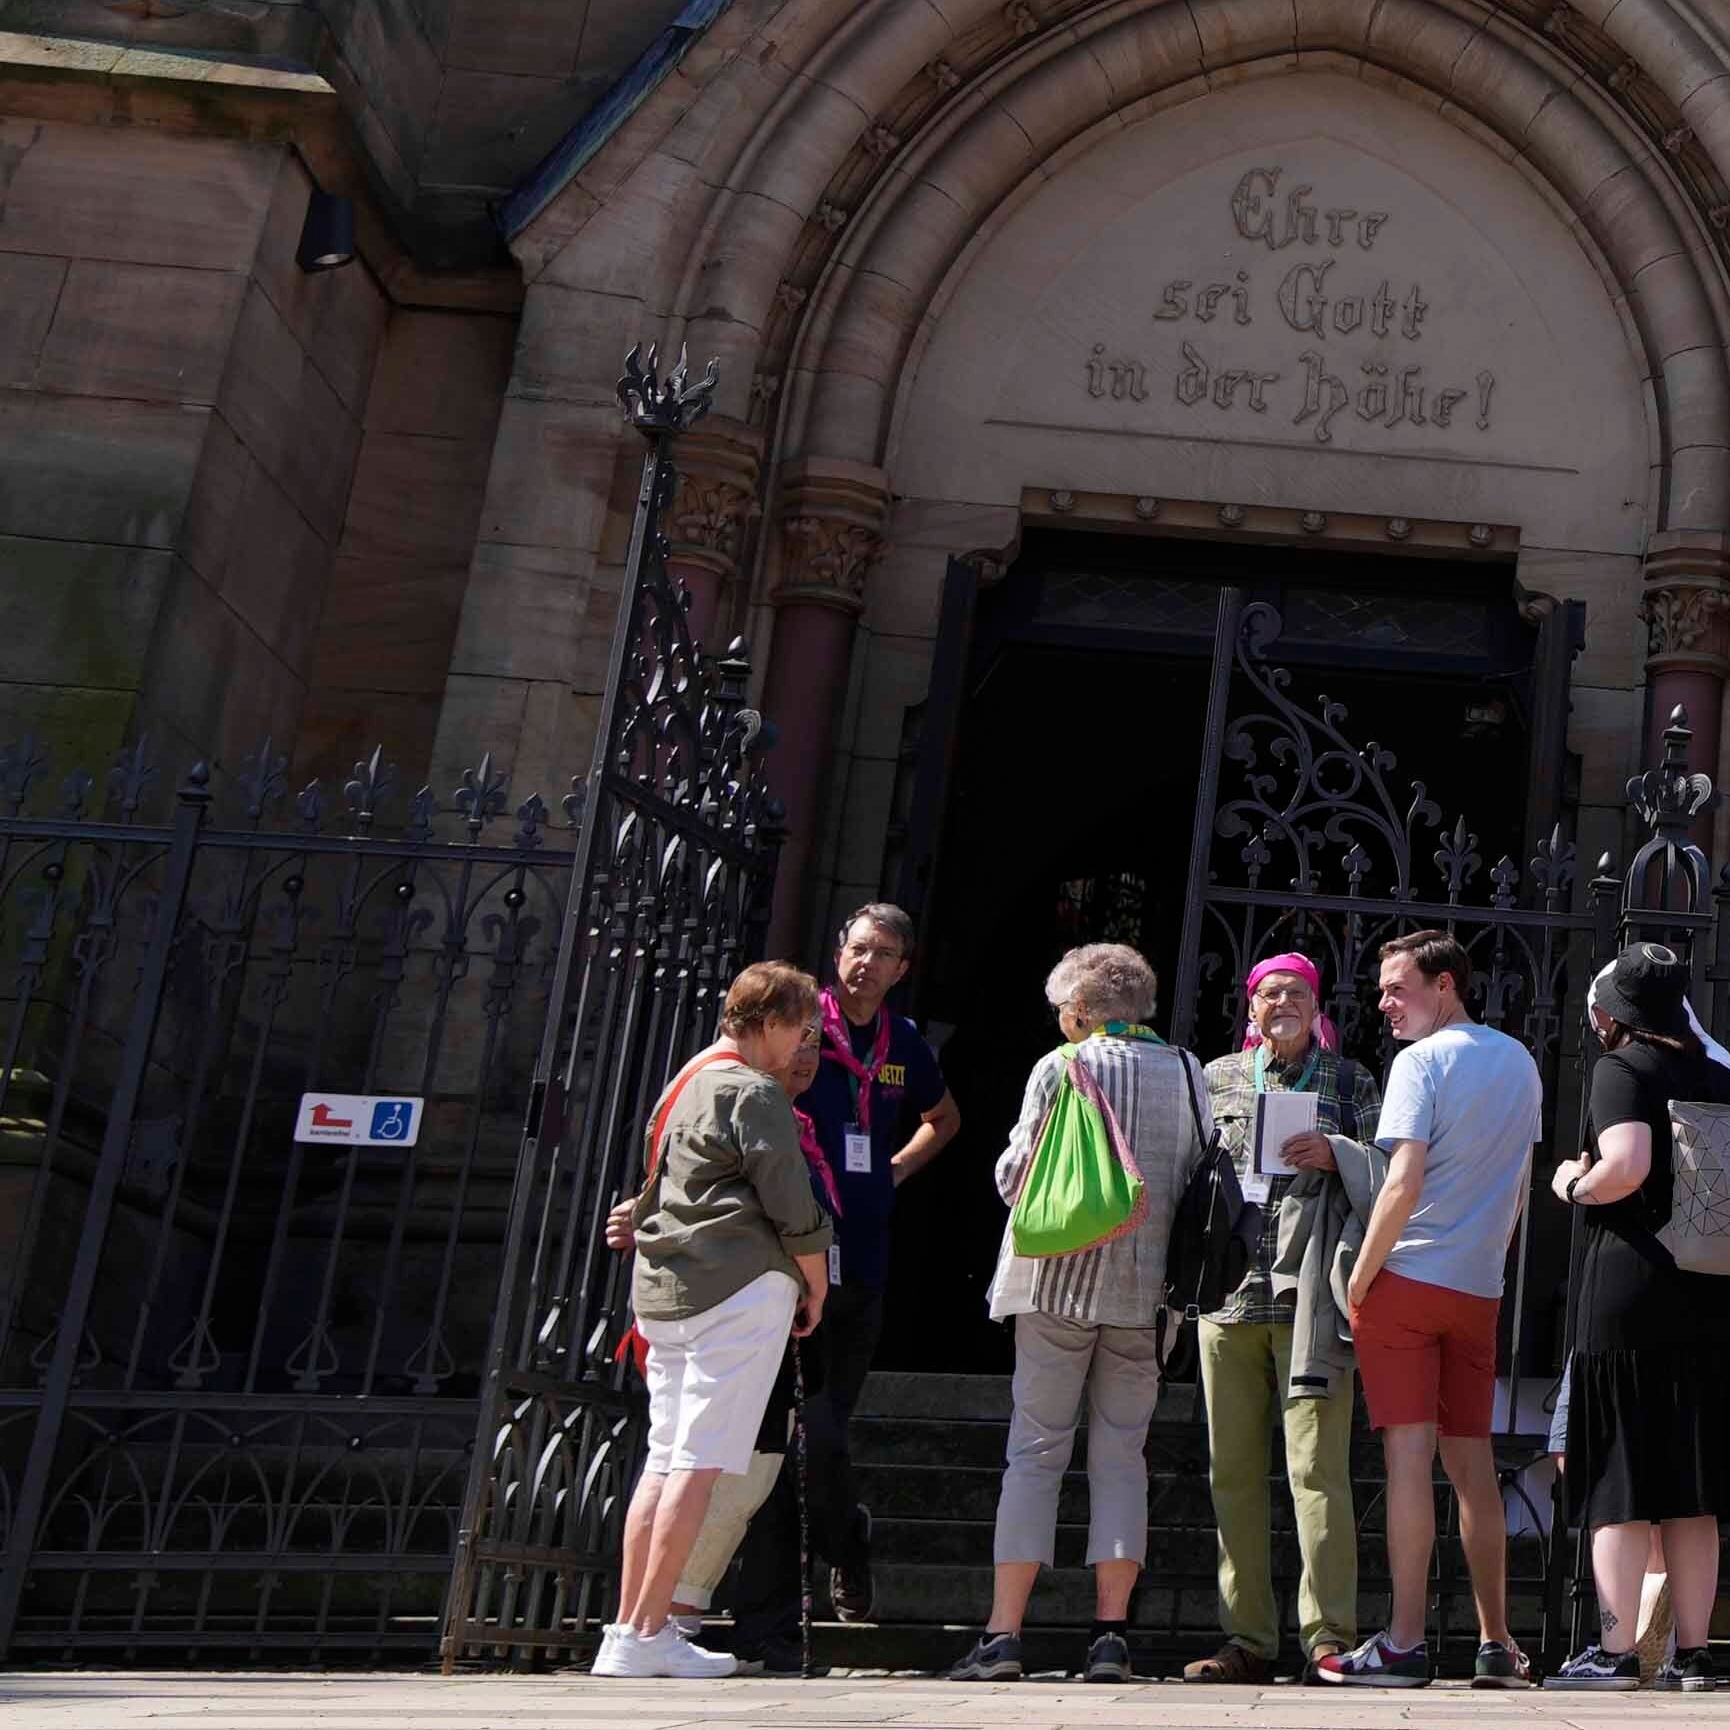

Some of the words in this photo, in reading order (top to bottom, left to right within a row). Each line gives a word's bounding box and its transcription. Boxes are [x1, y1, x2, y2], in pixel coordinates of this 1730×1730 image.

[1231, 166, 1389, 250] Ehre
[1153, 271, 1252, 326] sei
[1278, 259, 1429, 340] Gott
[1085, 343, 1149, 402] in
[1176, 342, 1280, 413] der
